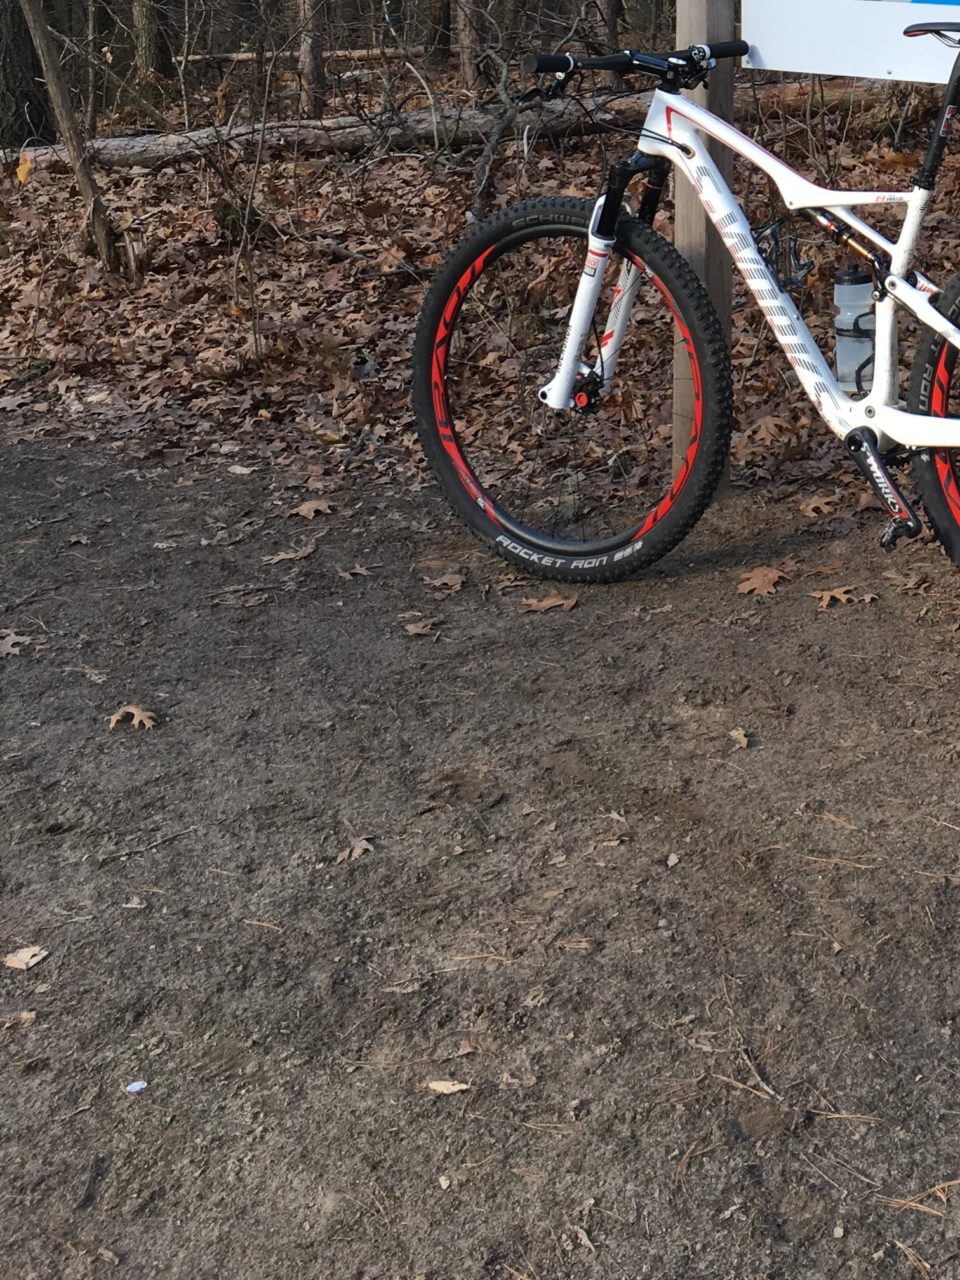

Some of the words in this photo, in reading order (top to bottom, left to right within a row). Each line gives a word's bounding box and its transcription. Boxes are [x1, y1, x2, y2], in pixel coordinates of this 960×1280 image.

[918, 362, 936, 412] RON
[860, 441, 900, 510] S-WORKS
[495, 534, 567, 568] ROCKET
[570, 556, 608, 569] RON
